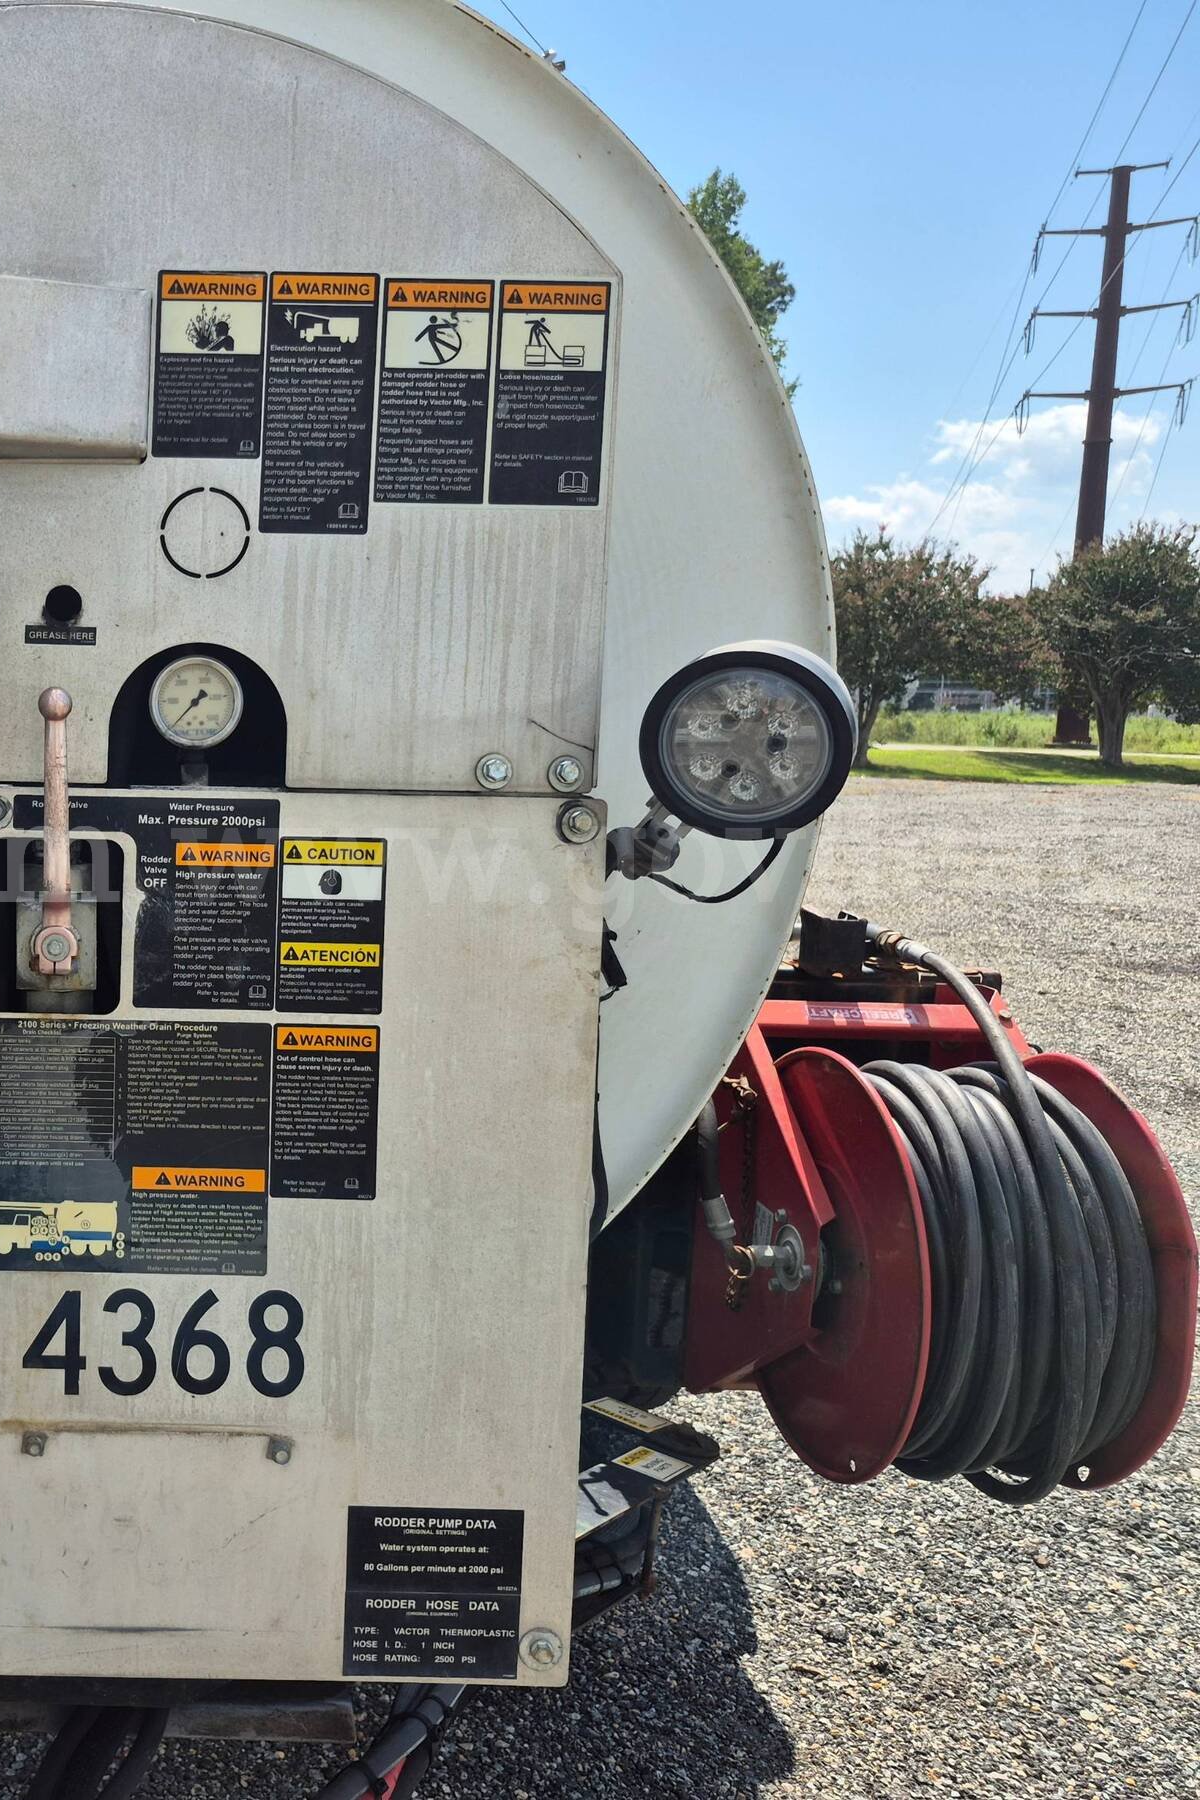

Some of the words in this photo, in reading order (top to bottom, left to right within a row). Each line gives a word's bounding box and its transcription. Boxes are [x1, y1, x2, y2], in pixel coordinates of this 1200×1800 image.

[182, 283, 257, 295] WARNING
[297, 283, 370, 295] WARNING
[413, 291, 487, 303] WARNING
[529, 292, 602, 305] WARNING
[298, 357, 317, 365] injury
[434, 372, 468, 380] jet-rodder
[382, 381, 414, 389] damaged
[29, 631, 67, 640] GREASE
[70, 632, 95, 640] HERE
[169, 803, 193, 812] Water
[197, 804, 234, 813] Pressure
[138, 814, 164, 825] Max.
[168, 815, 218, 826] Pressure
[222, 816, 265, 828] 2000psi
[141, 855, 171, 864] Rodder
[200, 850, 270, 863] WARNING
[307, 848, 375, 861] CAUTION
[144, 866, 167, 875] Valve
[176, 871, 195, 879] High
[144, 878, 167, 888] OFF
[300, 948, 376, 963] ATENCIÓN
[74, 1022, 110, 1031] Freezing
[174, 1024, 218, 1032] Procedure
[300, 1035, 372, 1047] WARNING
[322, 1064, 341, 1072] injury
[174, 1175, 245, 1187] WARNING
[23, 1288, 304, 1398] 4368
[374, 1518, 425, 1528] RODDER
[429, 1519, 462, 1529] PUMP
[466, 1519, 496, 1529] DATA
[407, 1544, 436, 1553] system
[439, 1545, 476, 1553] operates
[364, 1563, 374, 1571] 80
[377, 1564, 408, 1572] Gallons
[427, 1565, 456, 1573] minute
[491, 1567, 503, 1575] psi
[366, 1600, 416, 1609] RODDER
[426, 1601, 459, 1610] HOSE
[469, 1602, 499, 1611] DATA
[440, 1628, 515, 1637] THERMOPLASTIC
